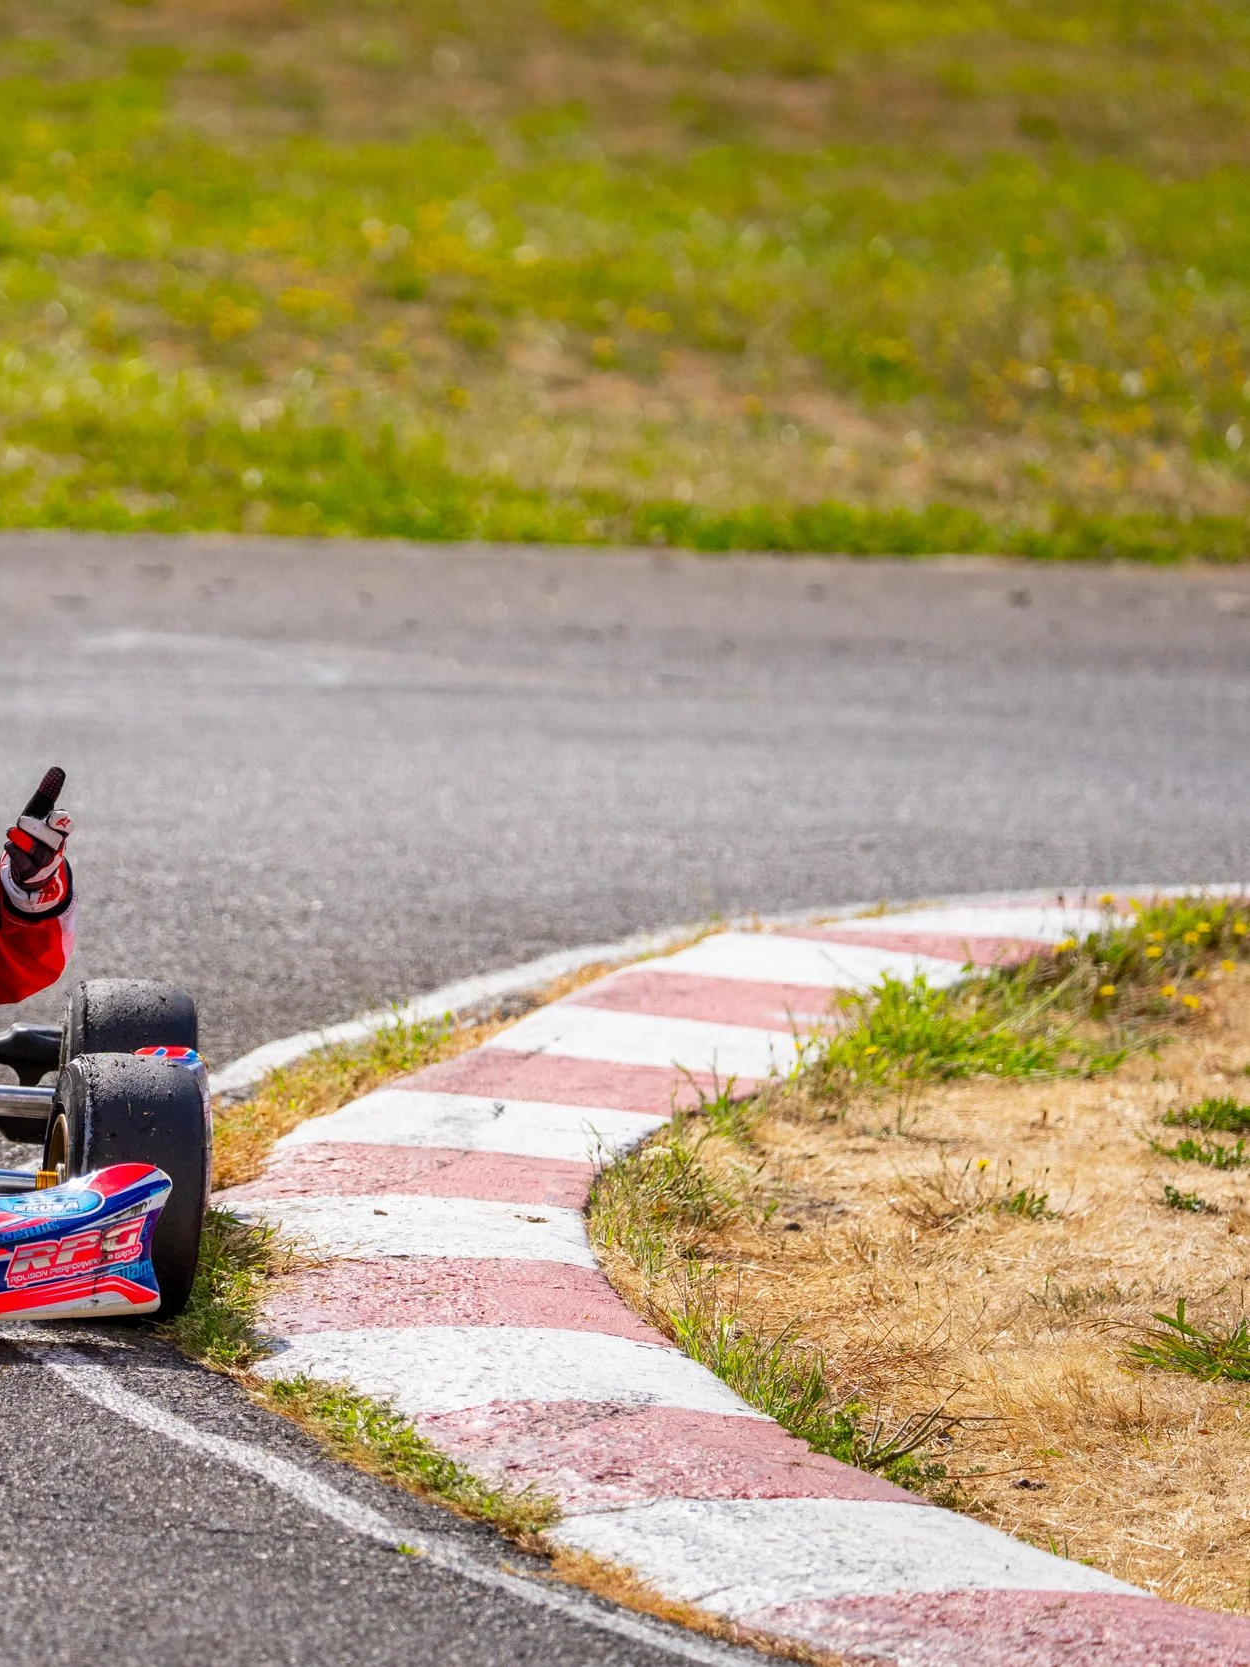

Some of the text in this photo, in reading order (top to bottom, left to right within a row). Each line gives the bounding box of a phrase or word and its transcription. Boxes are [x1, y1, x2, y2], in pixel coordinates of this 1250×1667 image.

[10, 1246, 140, 1283] ROLISON PERFORMAE GROUP
[12, 1222, 141, 1274] RPG
